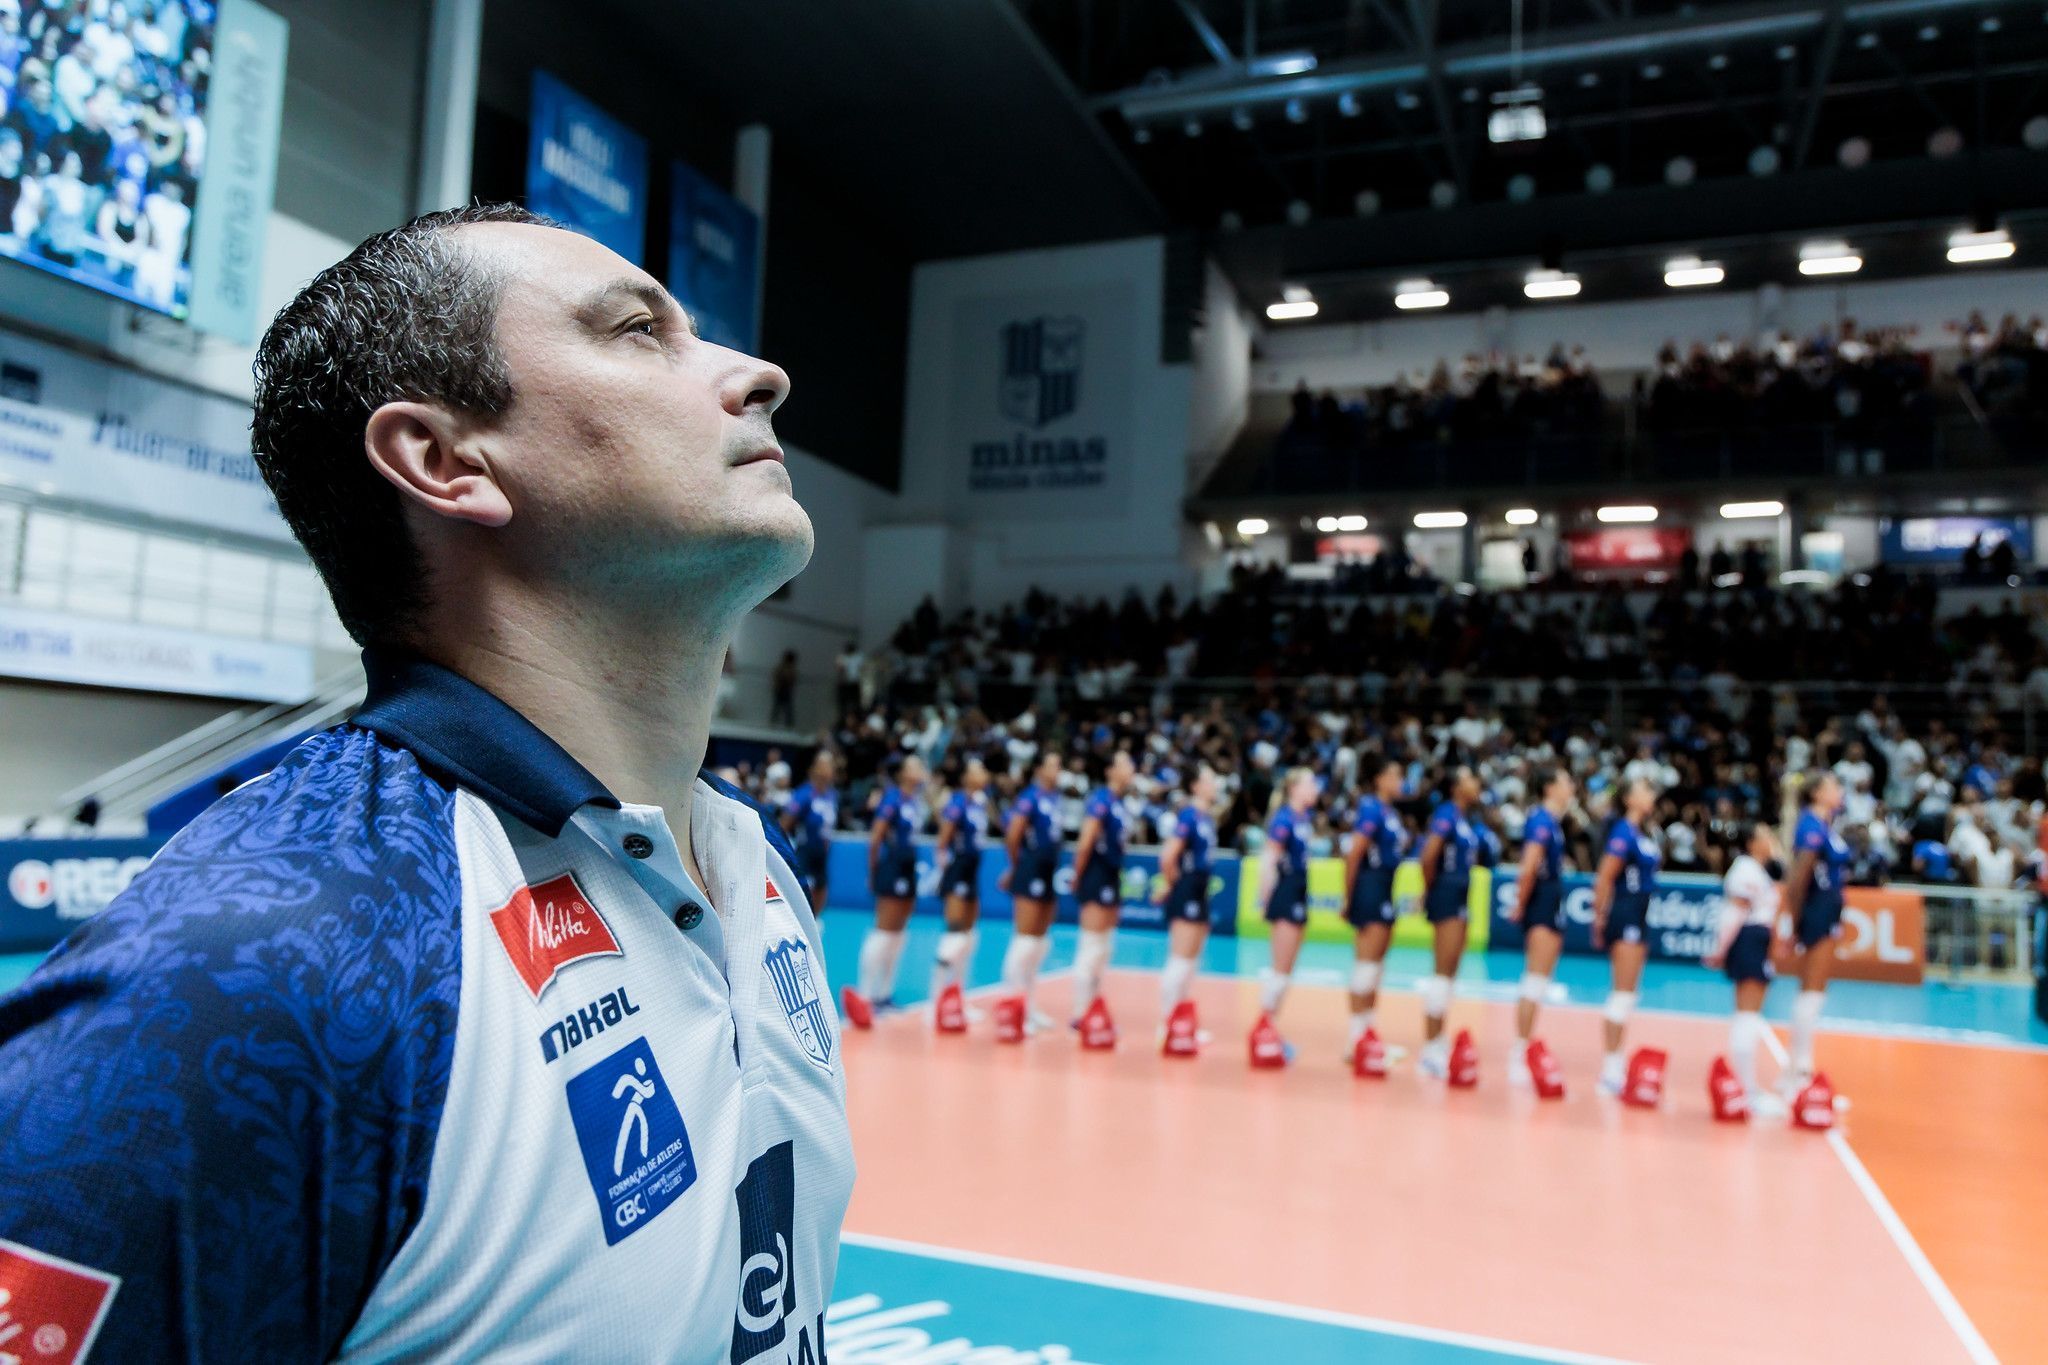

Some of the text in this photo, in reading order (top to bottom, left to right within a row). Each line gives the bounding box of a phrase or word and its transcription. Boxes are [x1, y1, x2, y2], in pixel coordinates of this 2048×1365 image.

[972, 433, 1107, 467] minas
[608, 1165, 649, 1200] FORMAÇÃO
[646, 1157, 658, 1172] DE
[656, 1138, 683, 1165] ATLETAS
[615, 1193, 646, 1228] CBC
